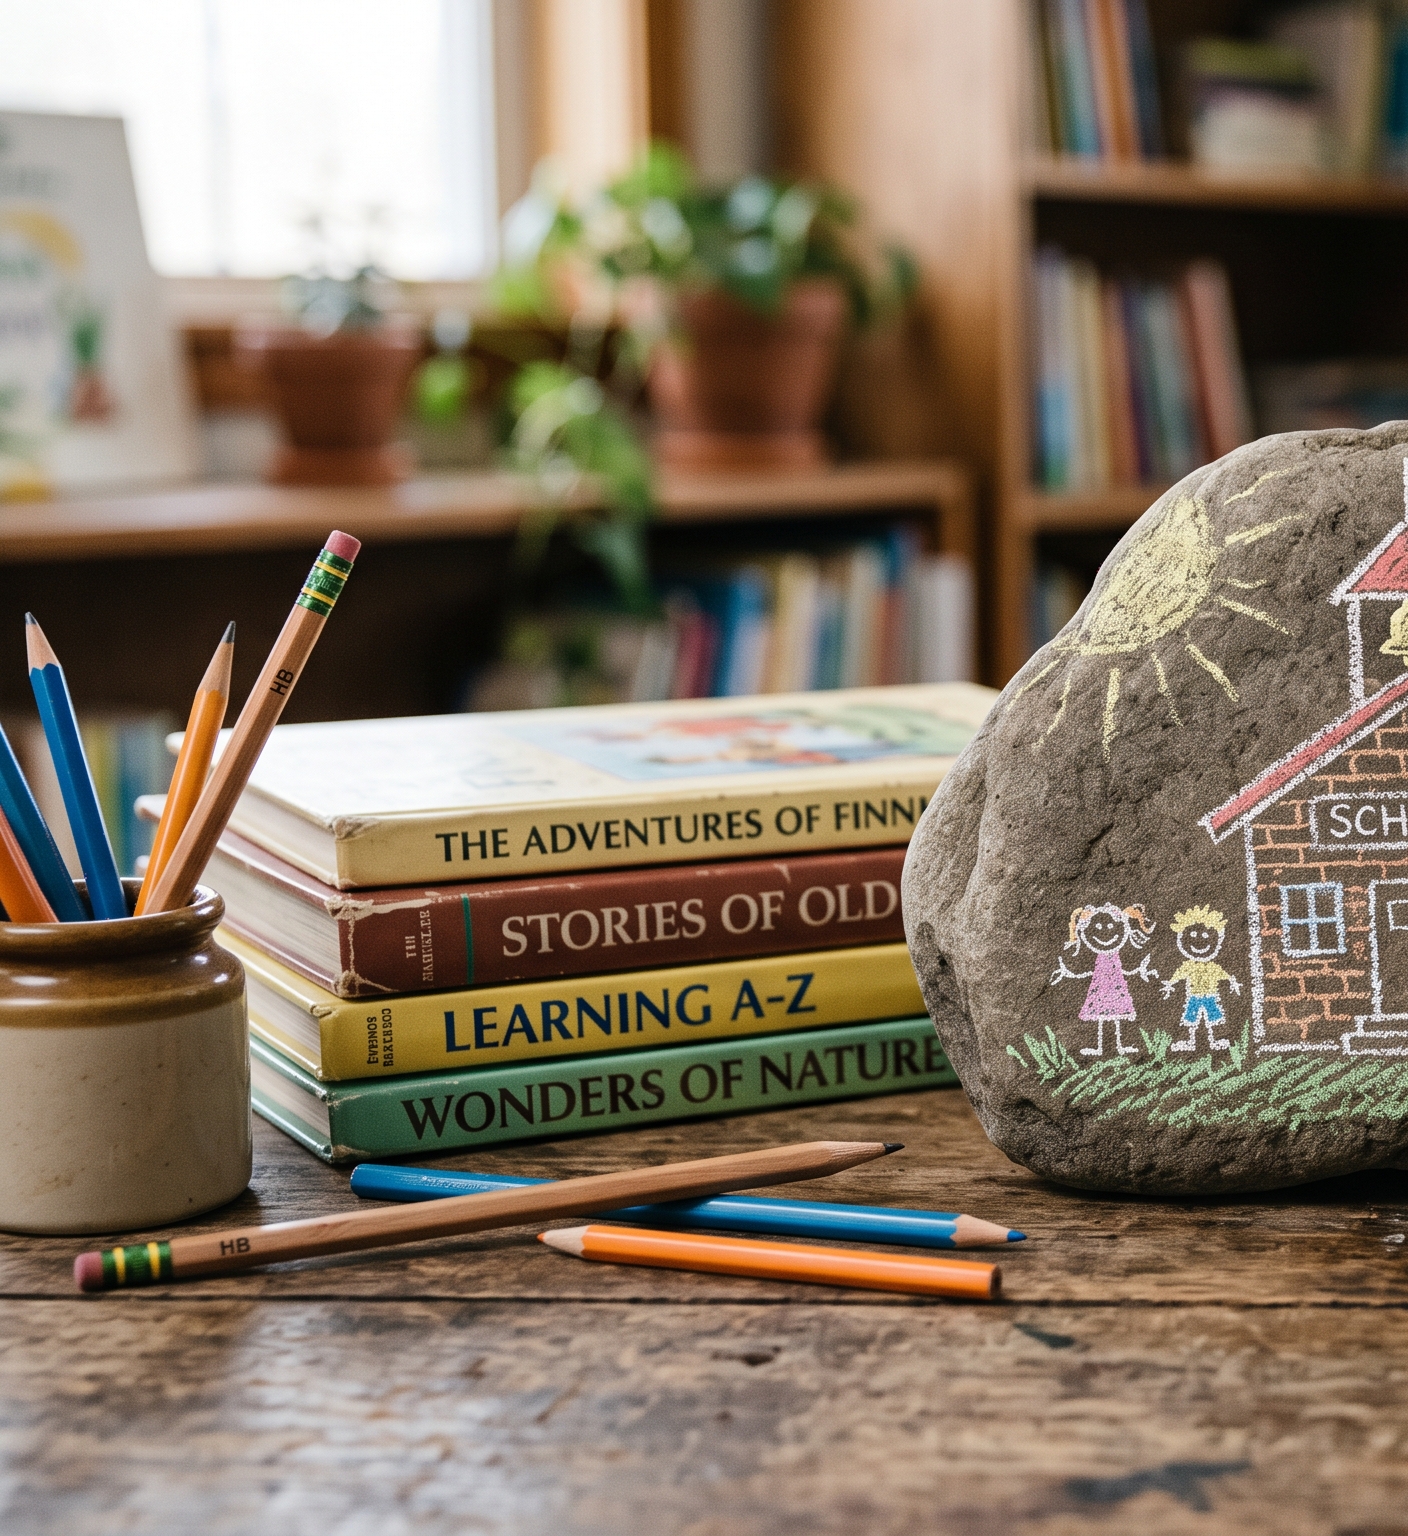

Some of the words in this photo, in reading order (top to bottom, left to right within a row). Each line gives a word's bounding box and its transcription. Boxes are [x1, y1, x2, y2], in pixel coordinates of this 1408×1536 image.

[269, 668, 294, 696] HB
[435, 828, 510, 862] THE
[522, 809, 762, 856] ADVENTURES
[775, 804, 820, 836] OF
[502, 898, 707, 957] STORIES
[721, 890, 785, 935] OF
[798, 880, 898, 927] OLD
[444, 983, 712, 1053] LEARNING
[731, 973, 817, 1021] A-Z
[401, 1069, 666, 1141] WONDERS
[680, 1059, 743, 1104] OF
[760, 1035, 947, 1095] NATURE
[219, 1237, 251, 1256] HB
